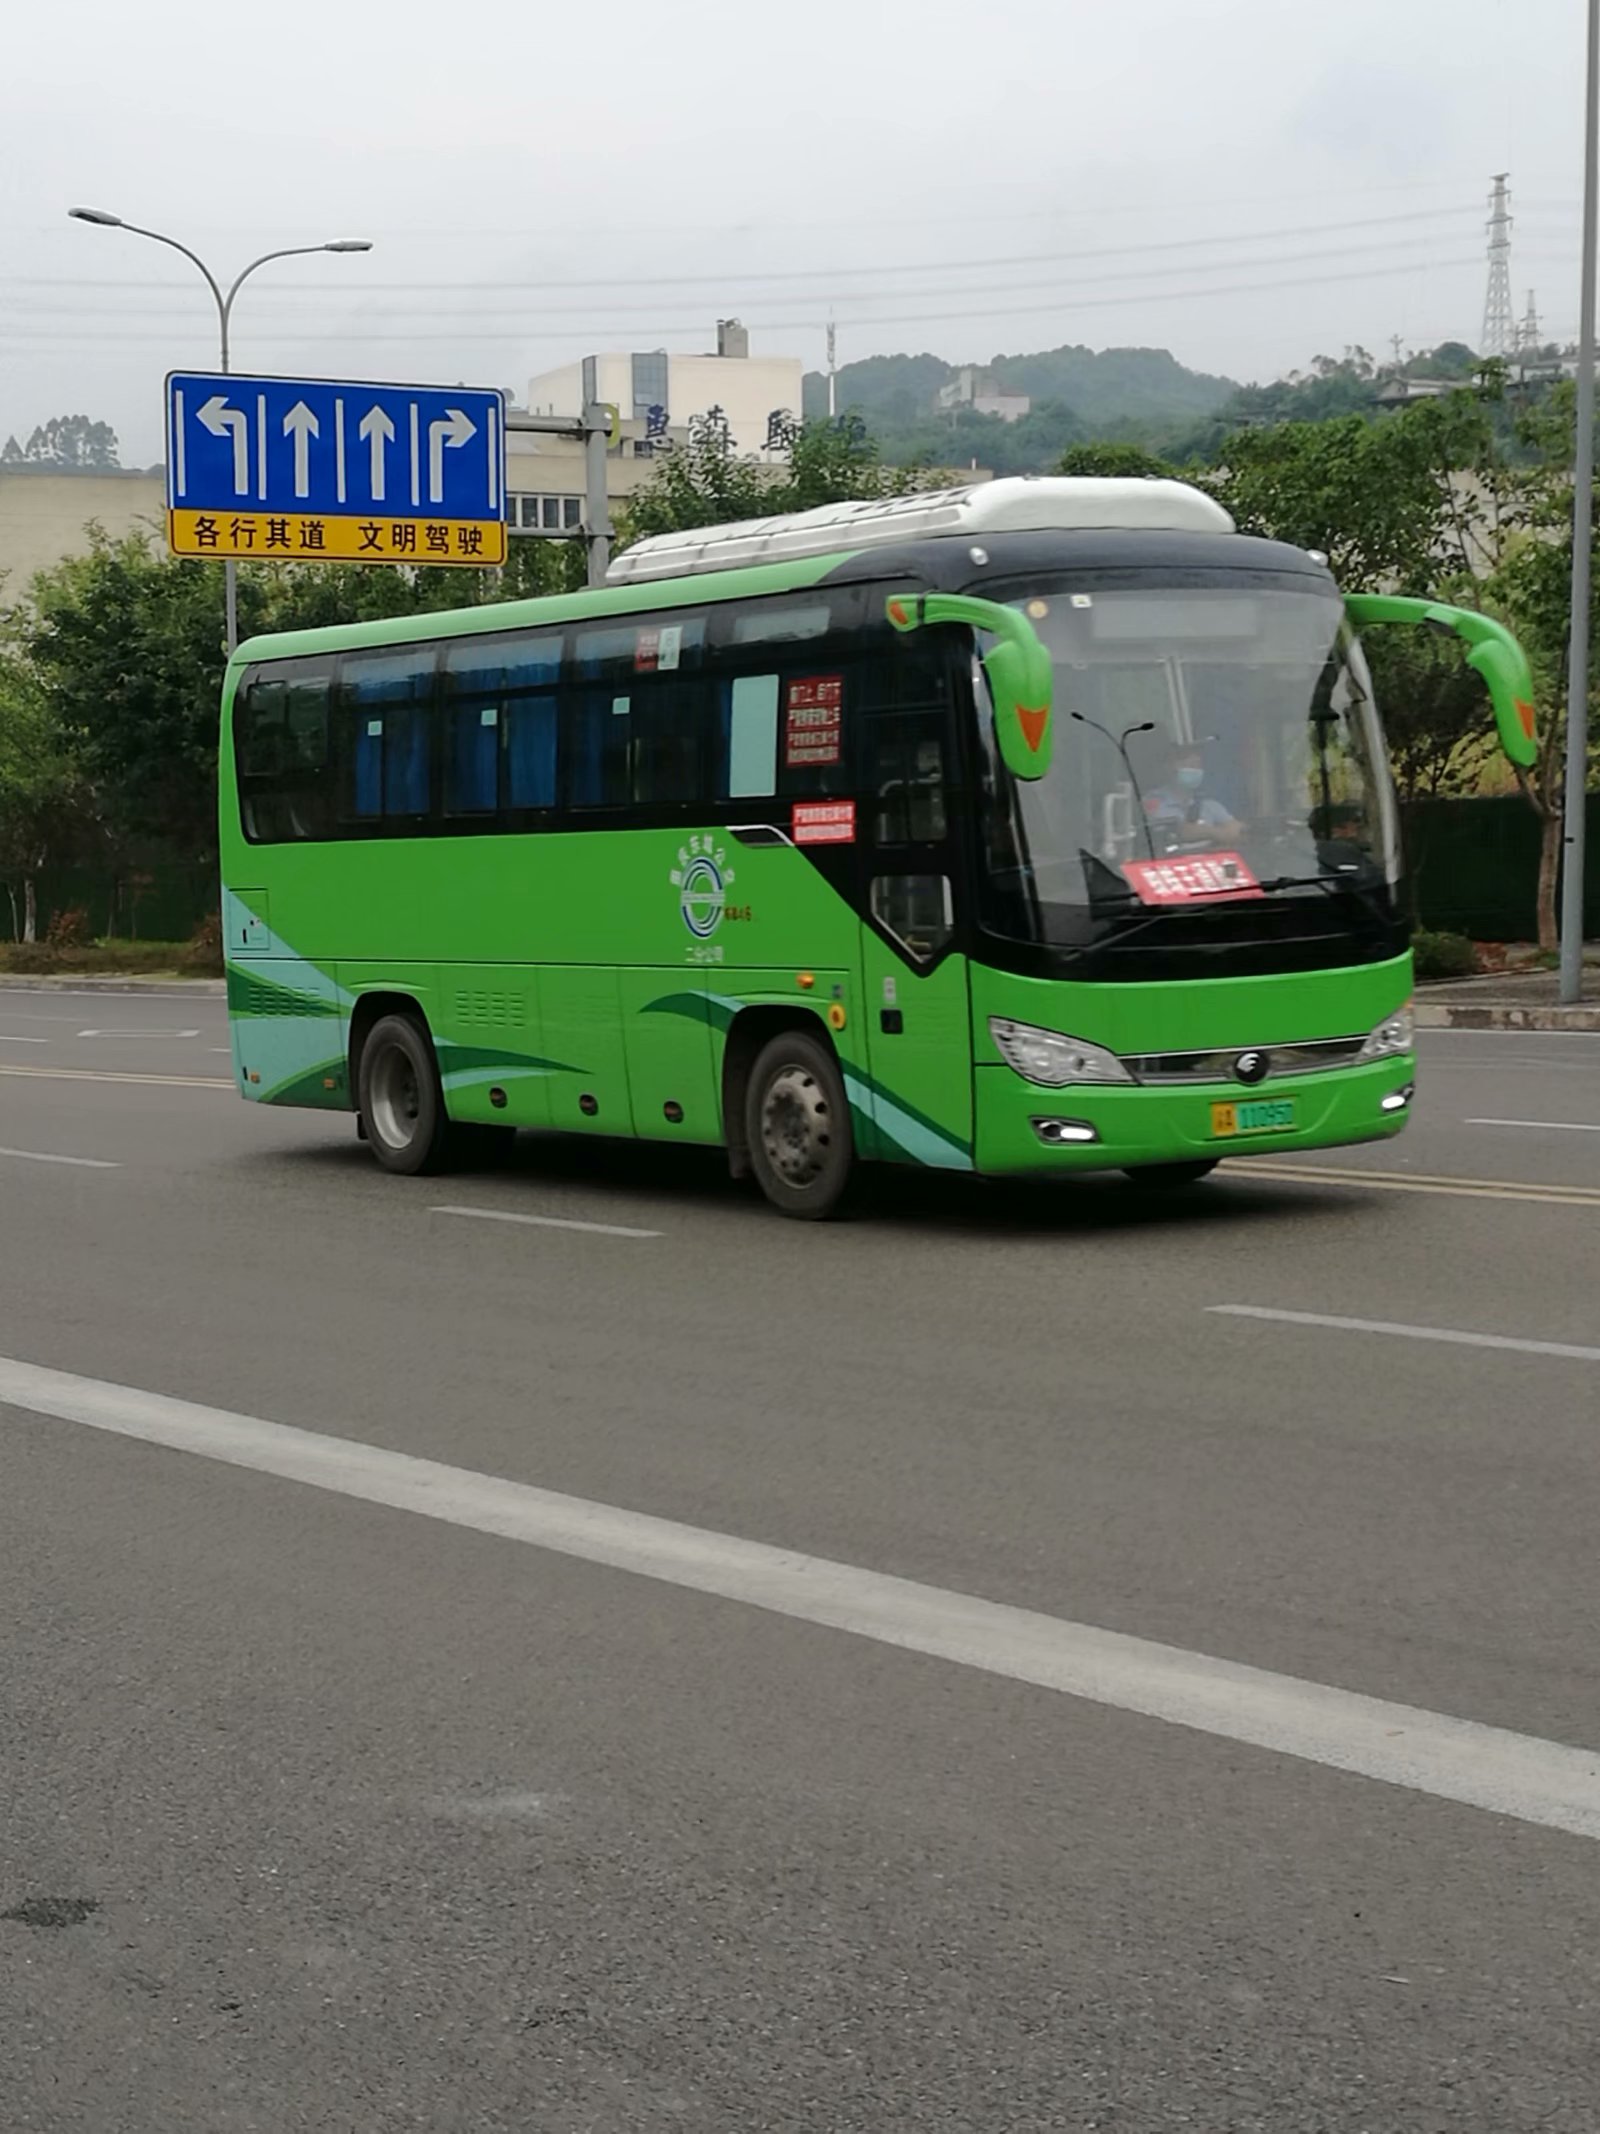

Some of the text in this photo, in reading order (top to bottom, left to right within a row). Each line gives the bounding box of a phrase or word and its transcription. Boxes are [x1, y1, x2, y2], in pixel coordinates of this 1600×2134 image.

[194, 516, 483, 556] 各行其道 文明驾驶
